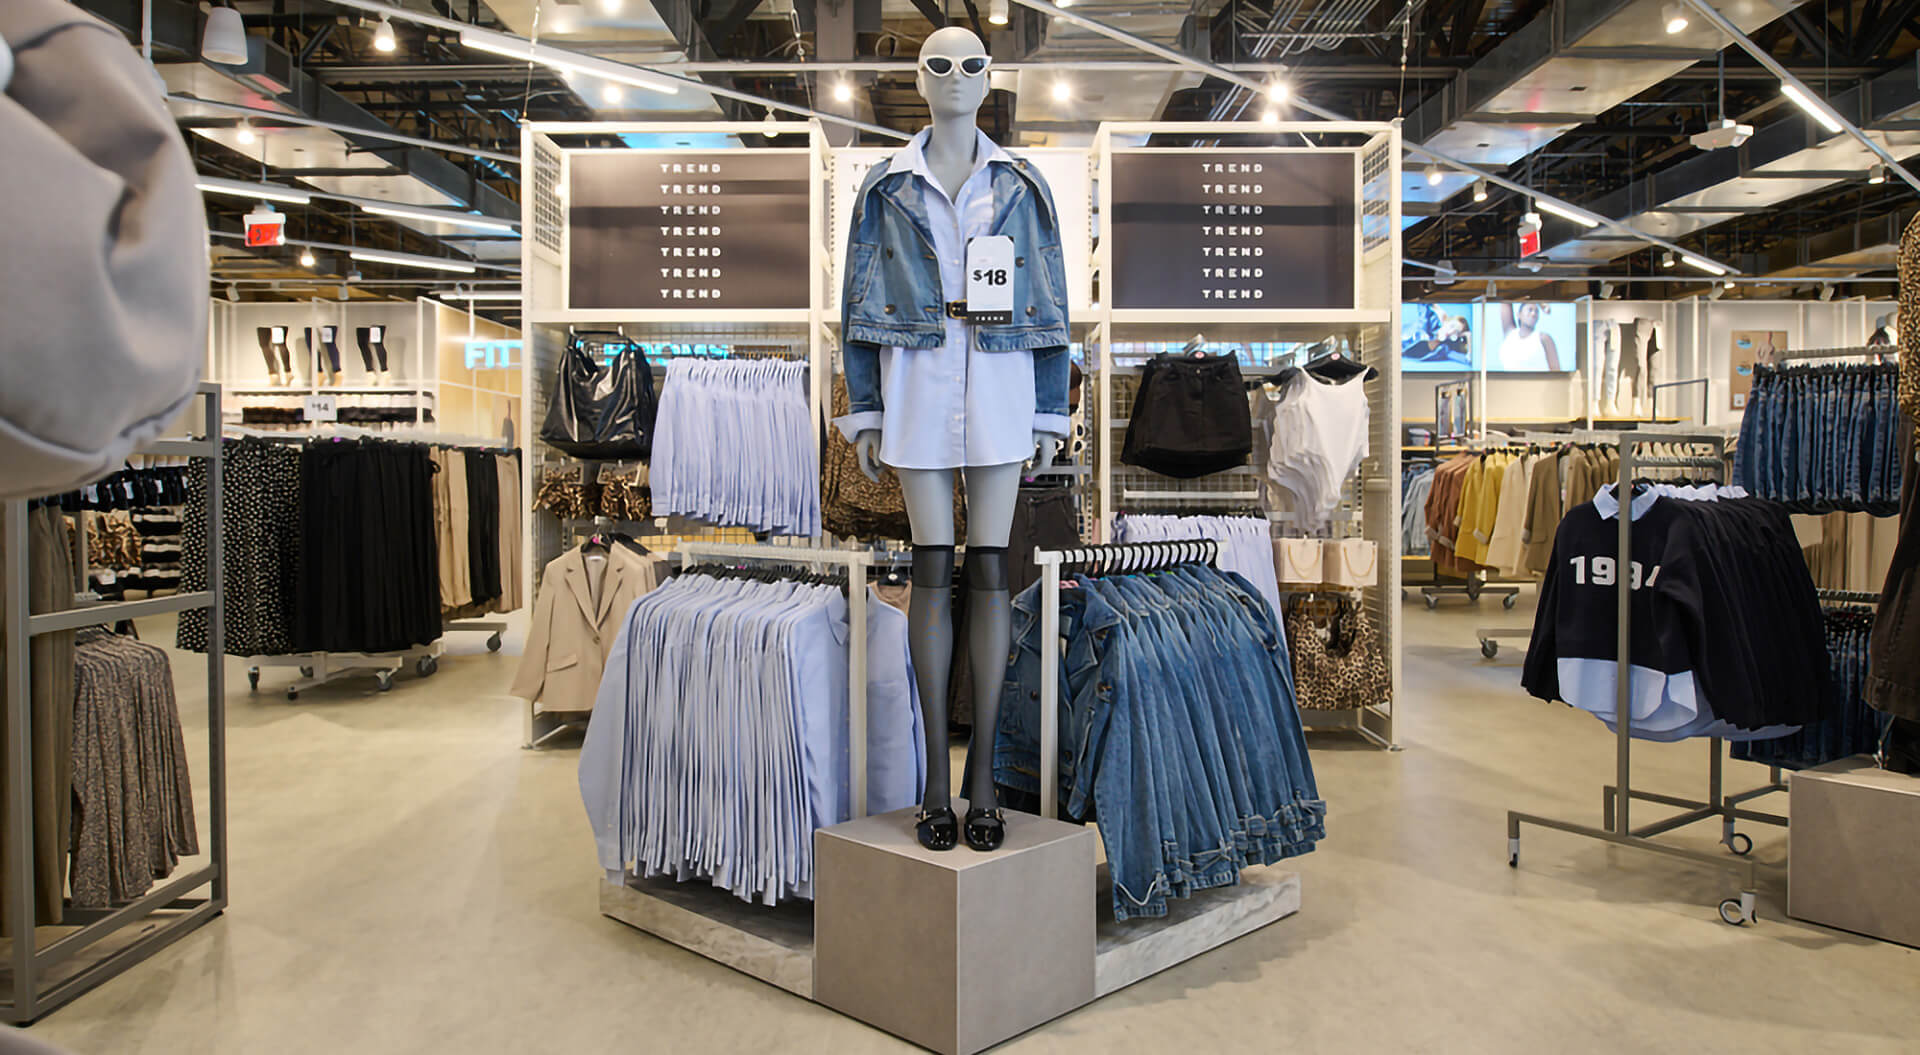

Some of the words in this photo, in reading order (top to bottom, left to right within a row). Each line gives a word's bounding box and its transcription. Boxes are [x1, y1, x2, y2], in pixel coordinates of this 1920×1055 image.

[660, 163, 721, 173] TREND
[1202, 163, 1263, 173] TREND
[660, 184, 721, 194] TREND
[1202, 184, 1263, 194] TREND
[660, 205, 721, 215] TREND
[1202, 205, 1263, 215] TREND
[660, 226, 721, 236] TREND
[1202, 226, 1263, 236] TREND
[660, 247, 721, 257] TREND
[1202, 247, 1263, 257] TREND
[660, 268, 721, 278] TREND
[973, 269, 1007, 286] $18
[1202, 268, 1263, 278] TREND
[660, 289, 721, 299] TREND
[1202, 289, 1263, 299] TREND
